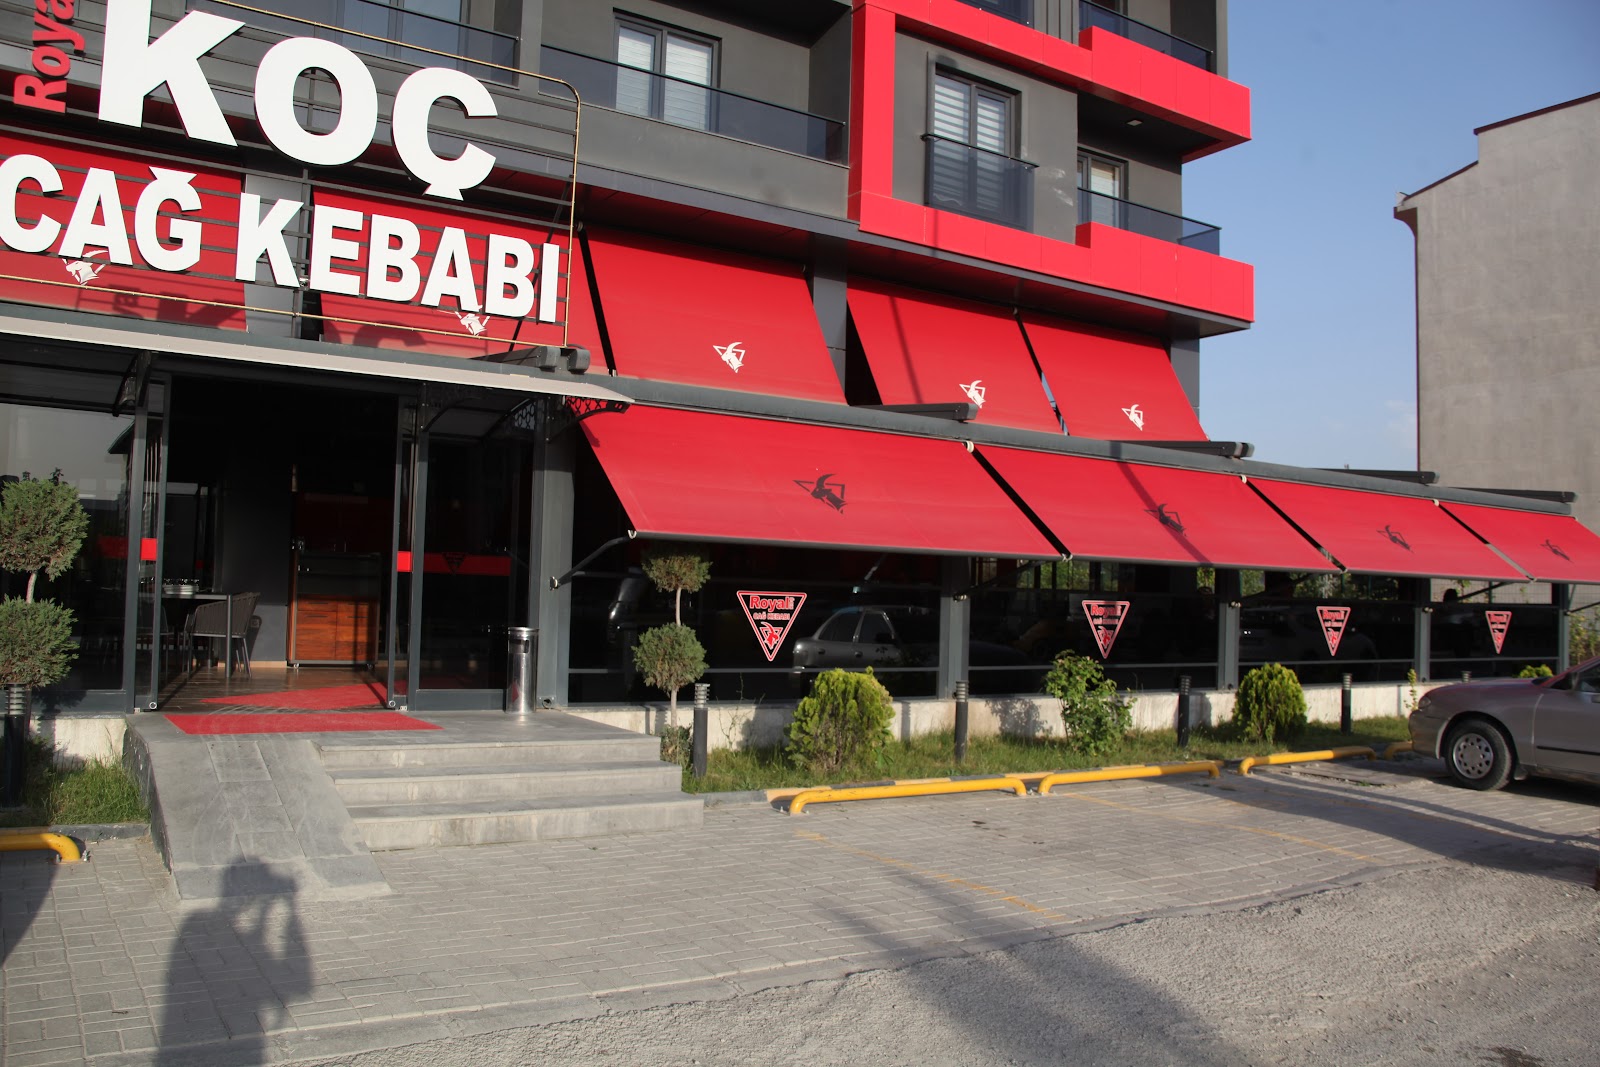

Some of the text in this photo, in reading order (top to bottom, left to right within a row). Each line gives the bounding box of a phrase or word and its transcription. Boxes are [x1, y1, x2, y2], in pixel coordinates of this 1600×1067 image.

[98, 0, 499, 201] KOÇ
[0, 154, 560, 323] CAĞ KEBABI
[749, 595, 789, 612] Royal
